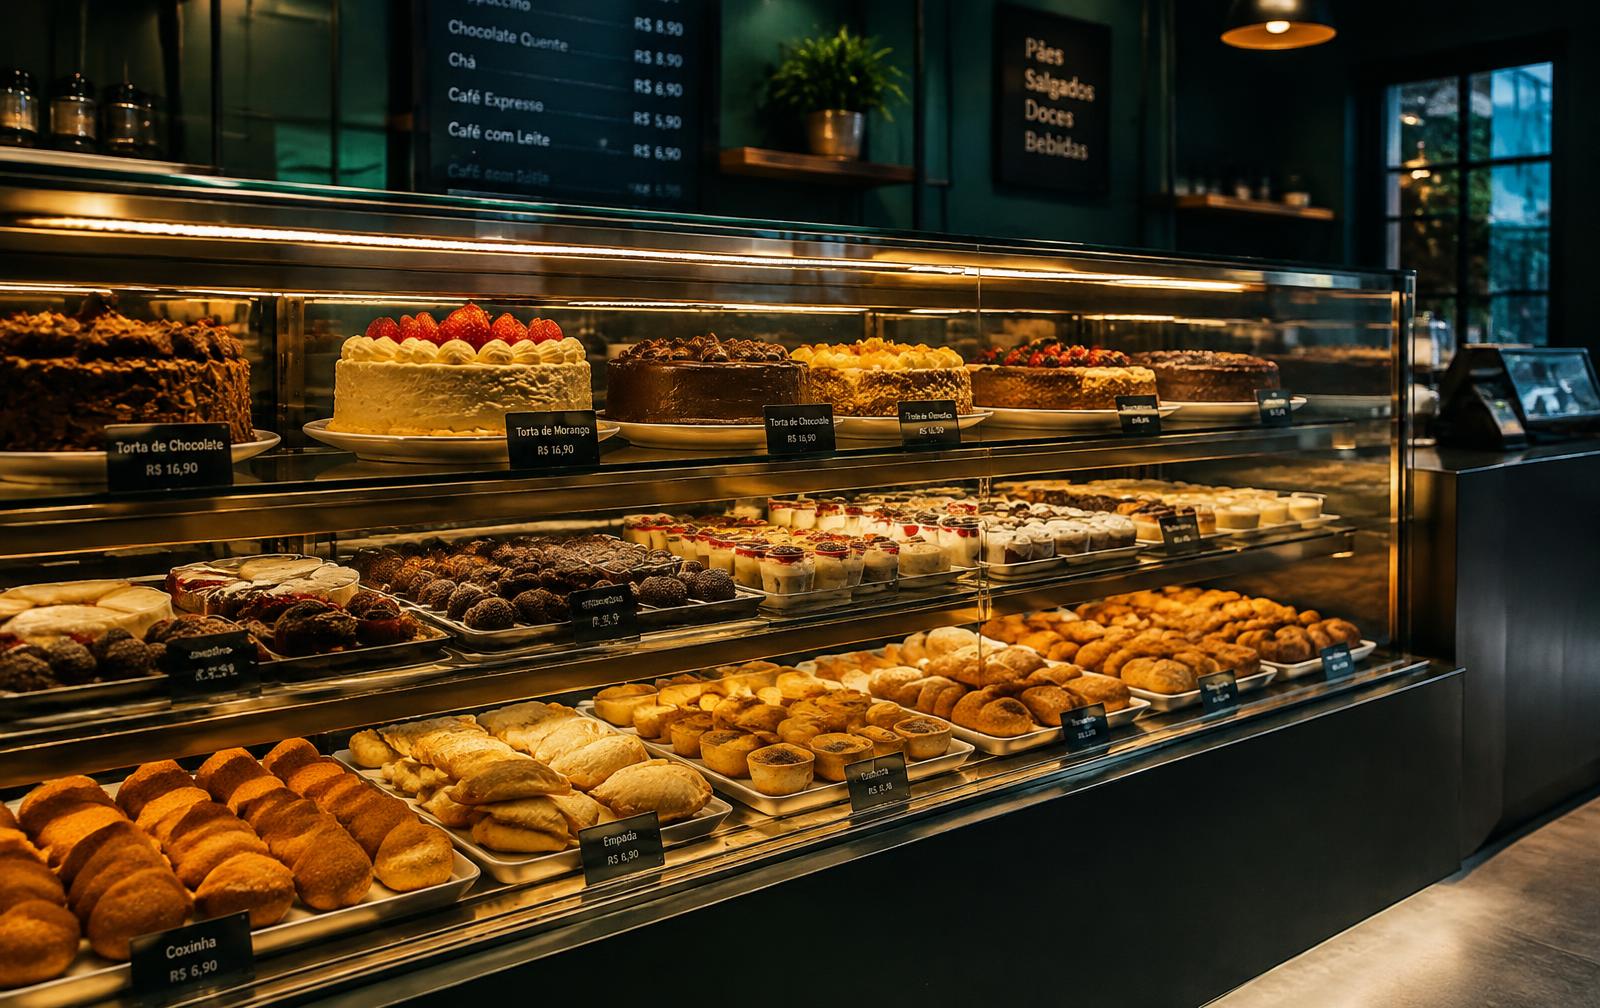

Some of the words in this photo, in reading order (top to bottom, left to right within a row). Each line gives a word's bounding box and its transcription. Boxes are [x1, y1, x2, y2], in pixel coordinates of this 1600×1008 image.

[448, 20, 517, 43] Chocolate
[521, 32, 568, 51] Quente
[1024, 68, 1094, 102] Salgados
[449, 87, 480, 104] Café
[485, 92, 543, 112] Expresso
[1025, 98, 1073, 127] Doces
[448, 122, 480, 139] Café
[485, 130, 514, 142] com
[518, 130, 550, 146] Leite
[1025, 131, 1088, 160] Bebidas
[516, 427, 539, 436] Torta
[542, 425, 552, 435] de
[554, 426, 589, 436] Morango
[770, 418, 788, 426] Torta
[790, 417, 797, 425] de
[116, 442, 148, 454] Torta
[152, 440, 166, 452] de
[170, 439, 223, 451] Chocolate
[552, 445, 573, 455] 16,90
[167, 463, 198, 475] 16,90
[603, 830, 637, 847] Empada
[166, 937, 217, 959] Coxinha
[191, 960, 217, 976] 6,90
